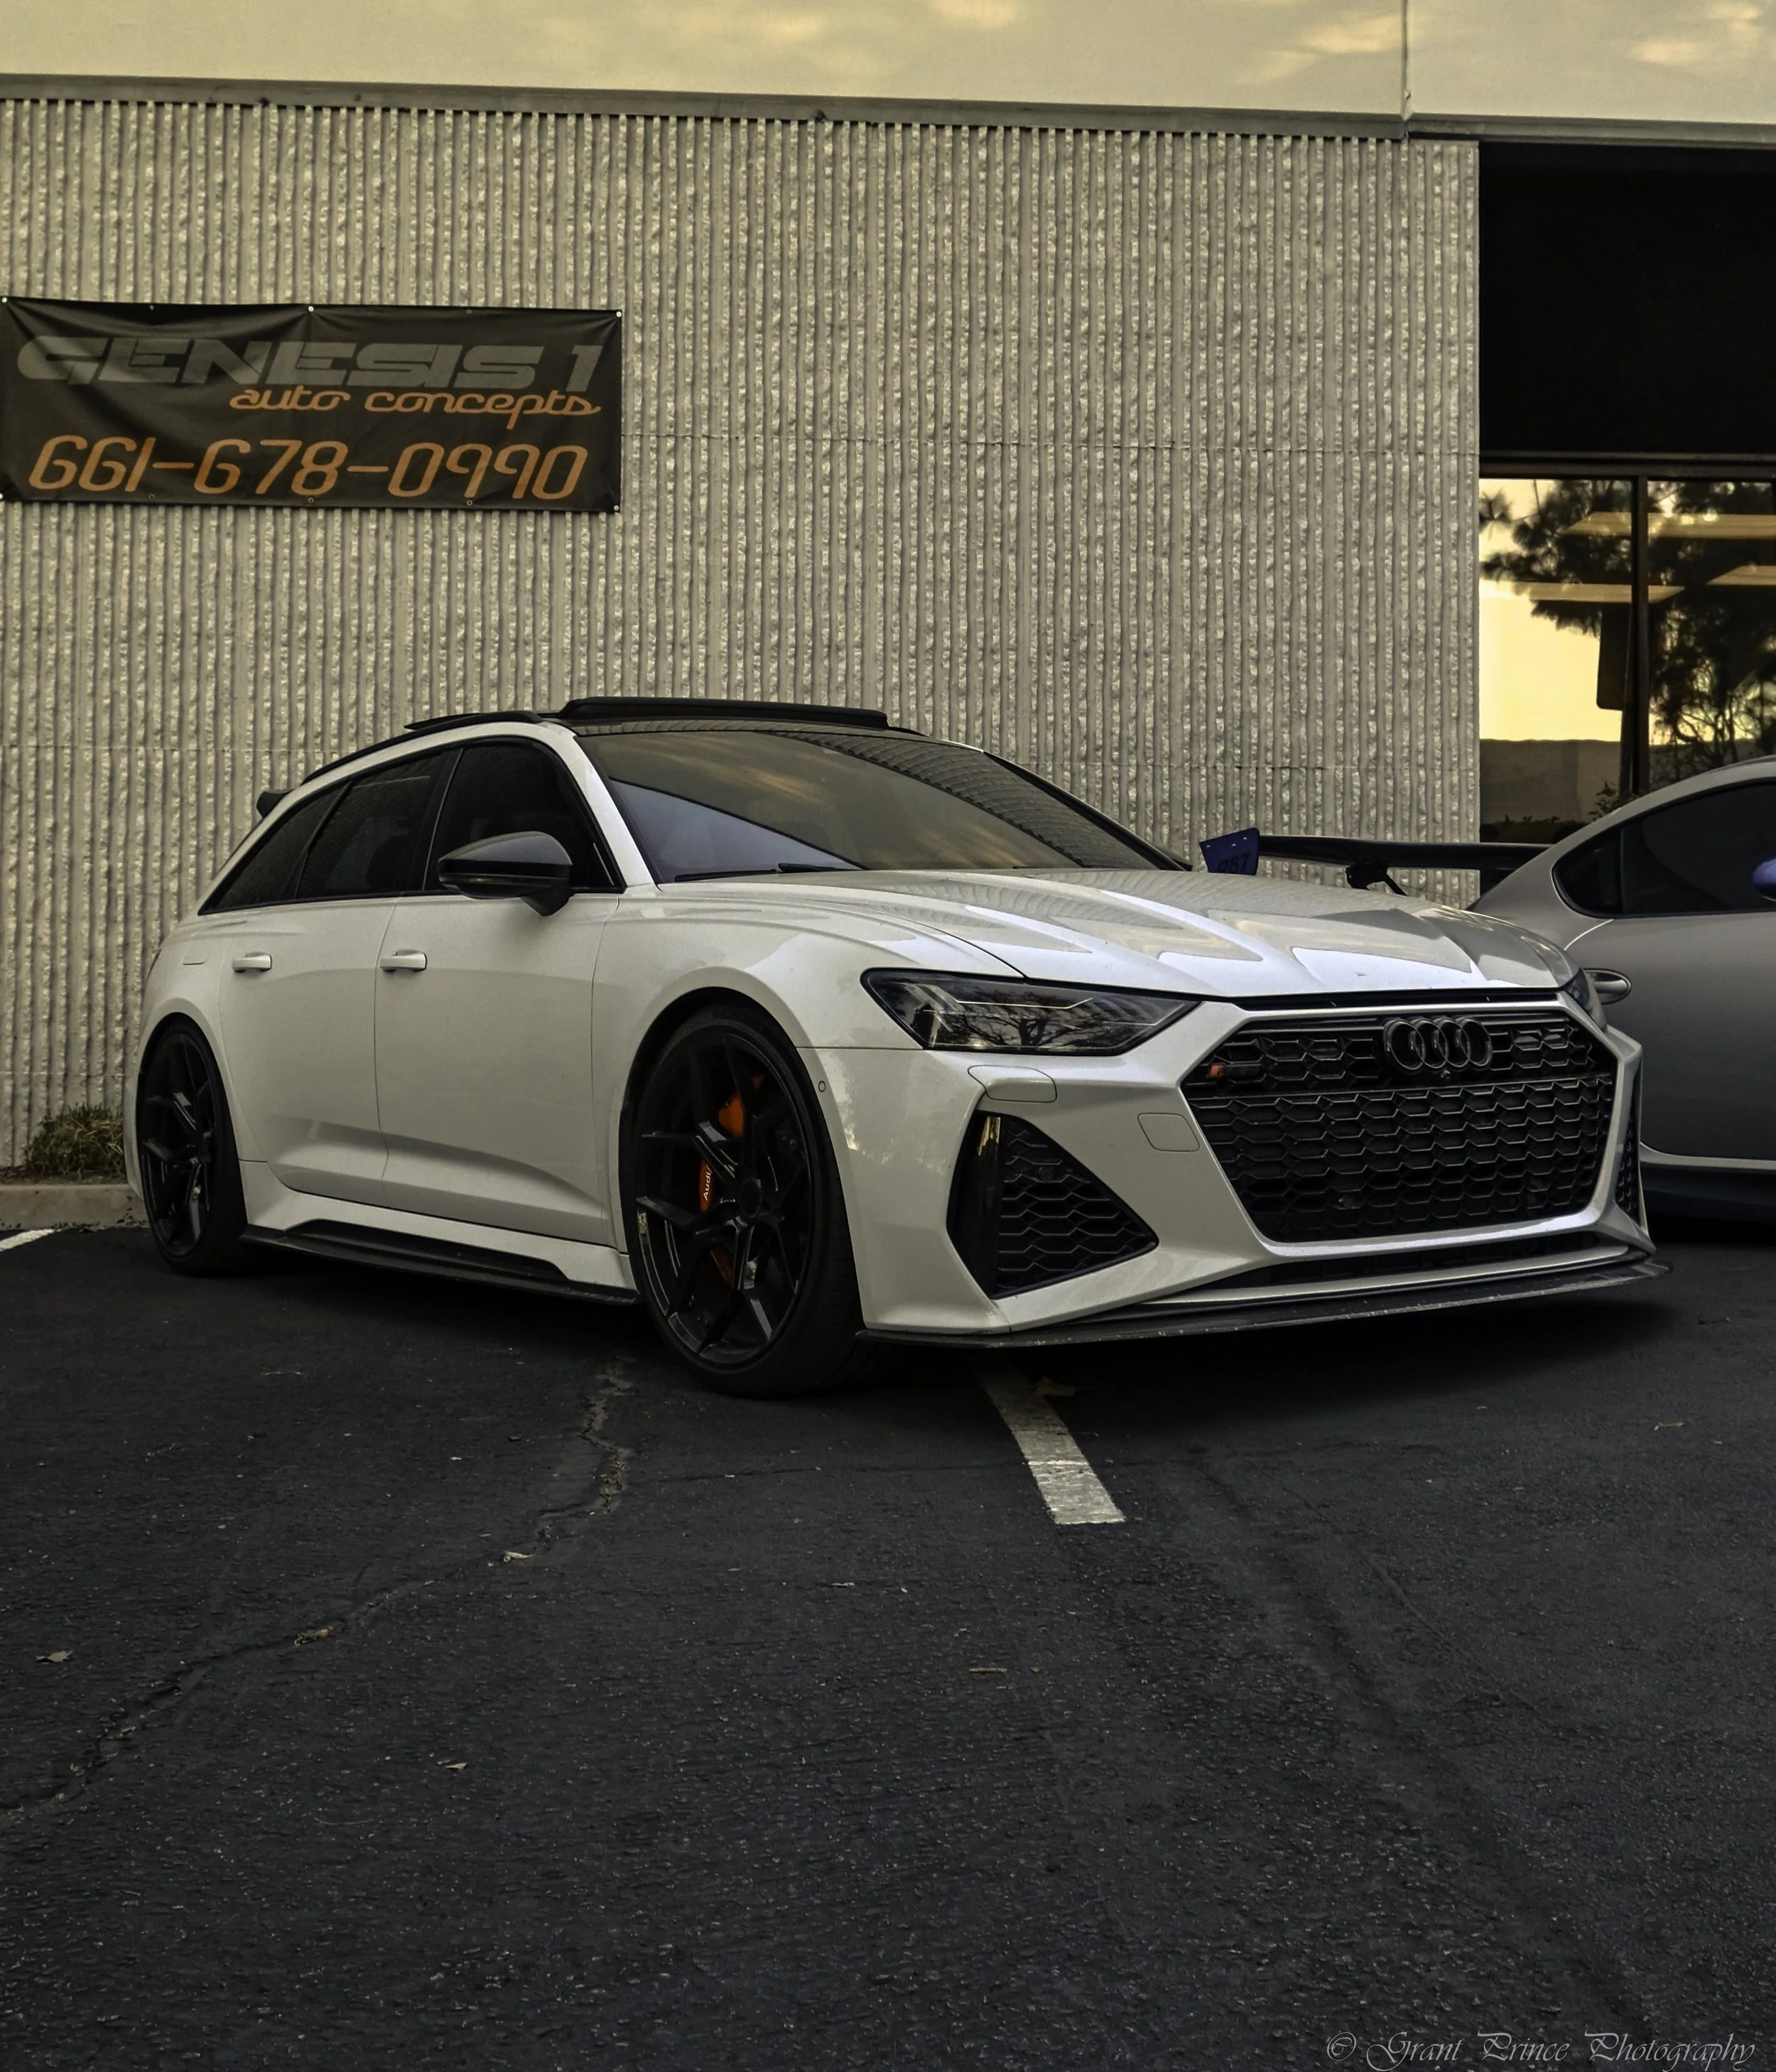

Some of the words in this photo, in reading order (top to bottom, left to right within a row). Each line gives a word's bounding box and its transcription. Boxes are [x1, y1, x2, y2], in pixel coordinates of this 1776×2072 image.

[17, 335, 544, 389] GENESIS
[565, 345, 602, 392] 1
[229, 384, 350, 411] auto
[364, 389, 601, 430] concepts
[28, 434, 589, 500] 661-678-0990
